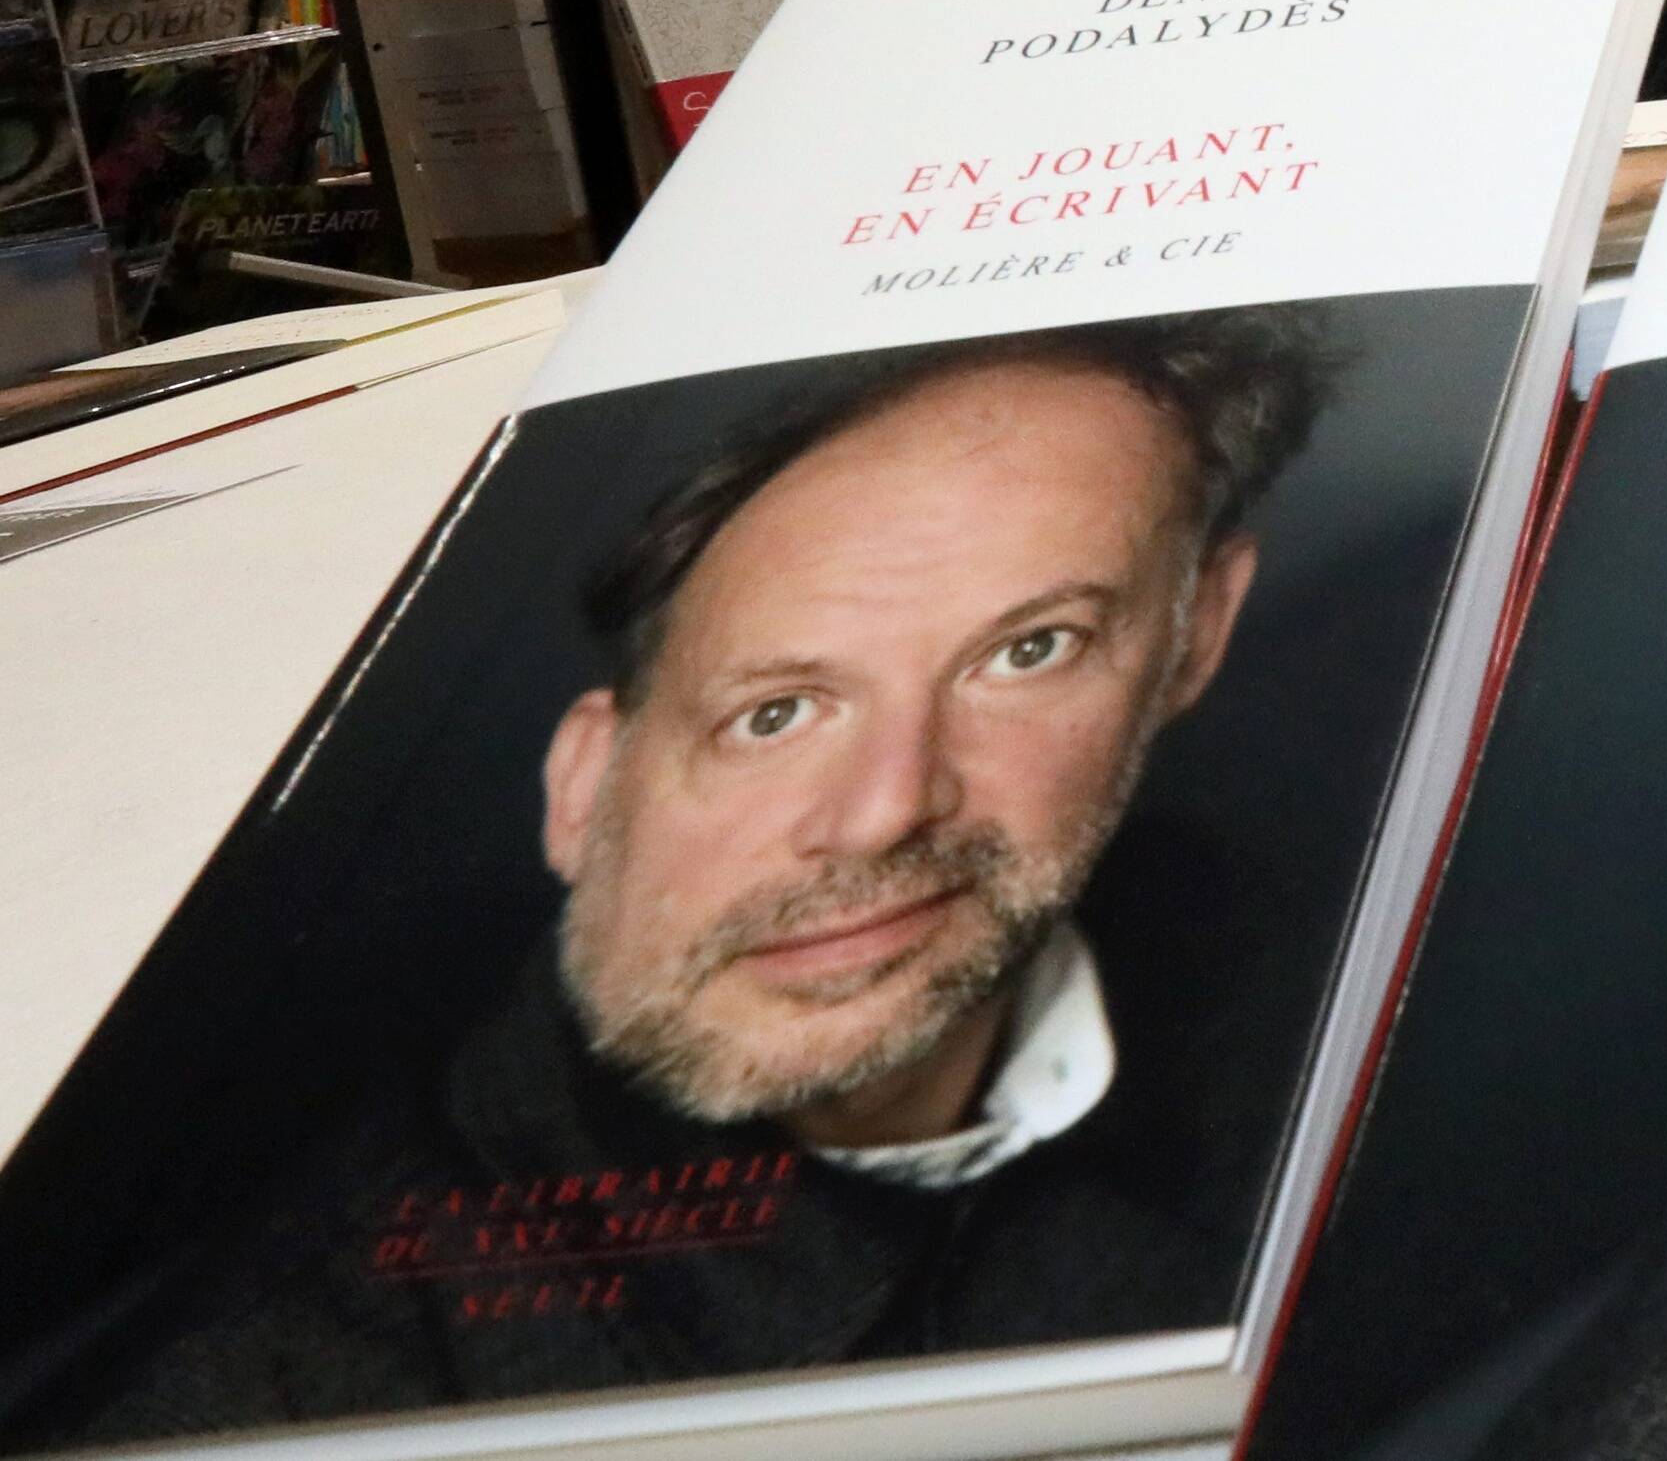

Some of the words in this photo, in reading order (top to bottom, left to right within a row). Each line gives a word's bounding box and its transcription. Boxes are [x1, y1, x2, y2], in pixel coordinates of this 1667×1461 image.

[903, 157, 991, 196] EN
[1019, 122, 1295, 181] JOUANT,
[842, 207, 934, 246] EN
[963, 161, 1320, 231] ÉCRIVANT
[861, 250, 1085, 297] MOLIÈRE
[1104, 245, 1132, 268] &
[1160, 231, 1242, 262] CIE
